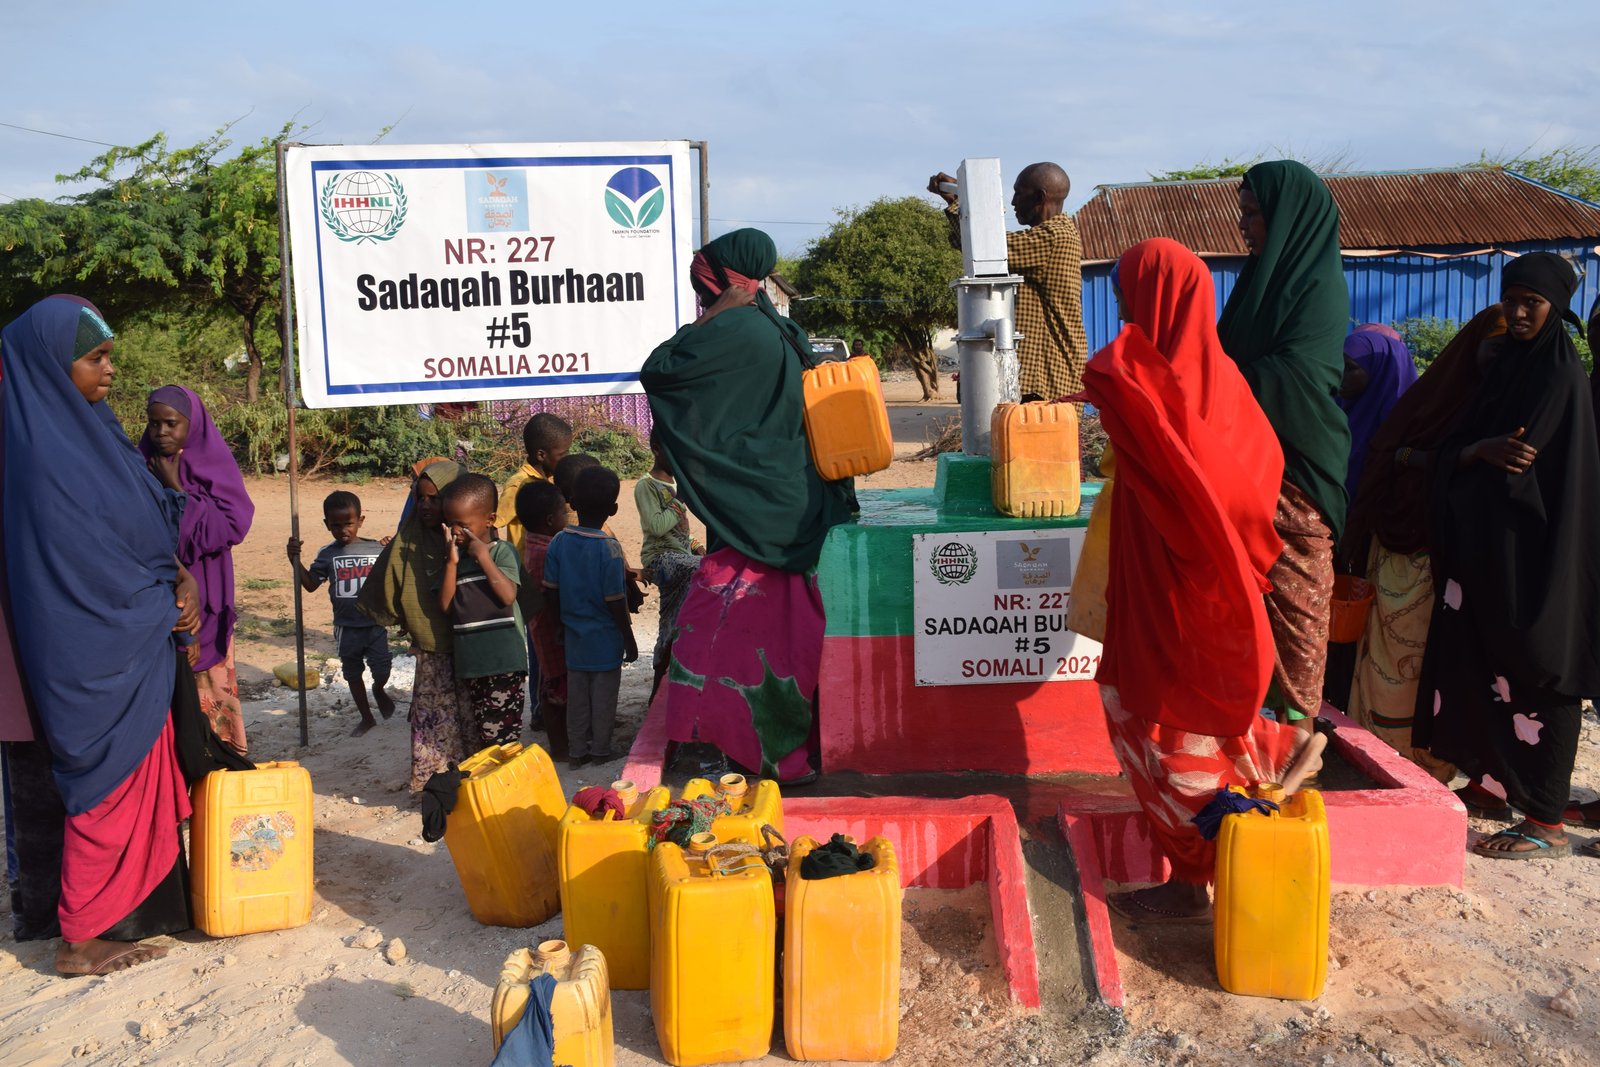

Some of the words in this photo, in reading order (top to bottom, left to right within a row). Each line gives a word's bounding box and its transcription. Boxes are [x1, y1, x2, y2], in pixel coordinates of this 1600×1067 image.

[334, 197, 393, 208] IHHNL
[444, 239, 496, 265] NR:
[507, 236, 556, 263] 227
[357, 271, 501, 312] Sadaqah
[510, 268, 644, 306] Burhaan
[486, 312, 532, 349] #5
[424, 355, 531, 379] SOMALIA
[538, 352, 590, 374] 2021
[336, 557, 376, 569] NEVER
[937, 557, 970, 566] IHHNL
[338, 577, 367, 596] U
[994, 594, 1031, 612] NR:
[924, 615, 1027, 635] SADAQAH
[1015, 637, 1051, 655] #5
[961, 658, 1044, 678] SOMALI
